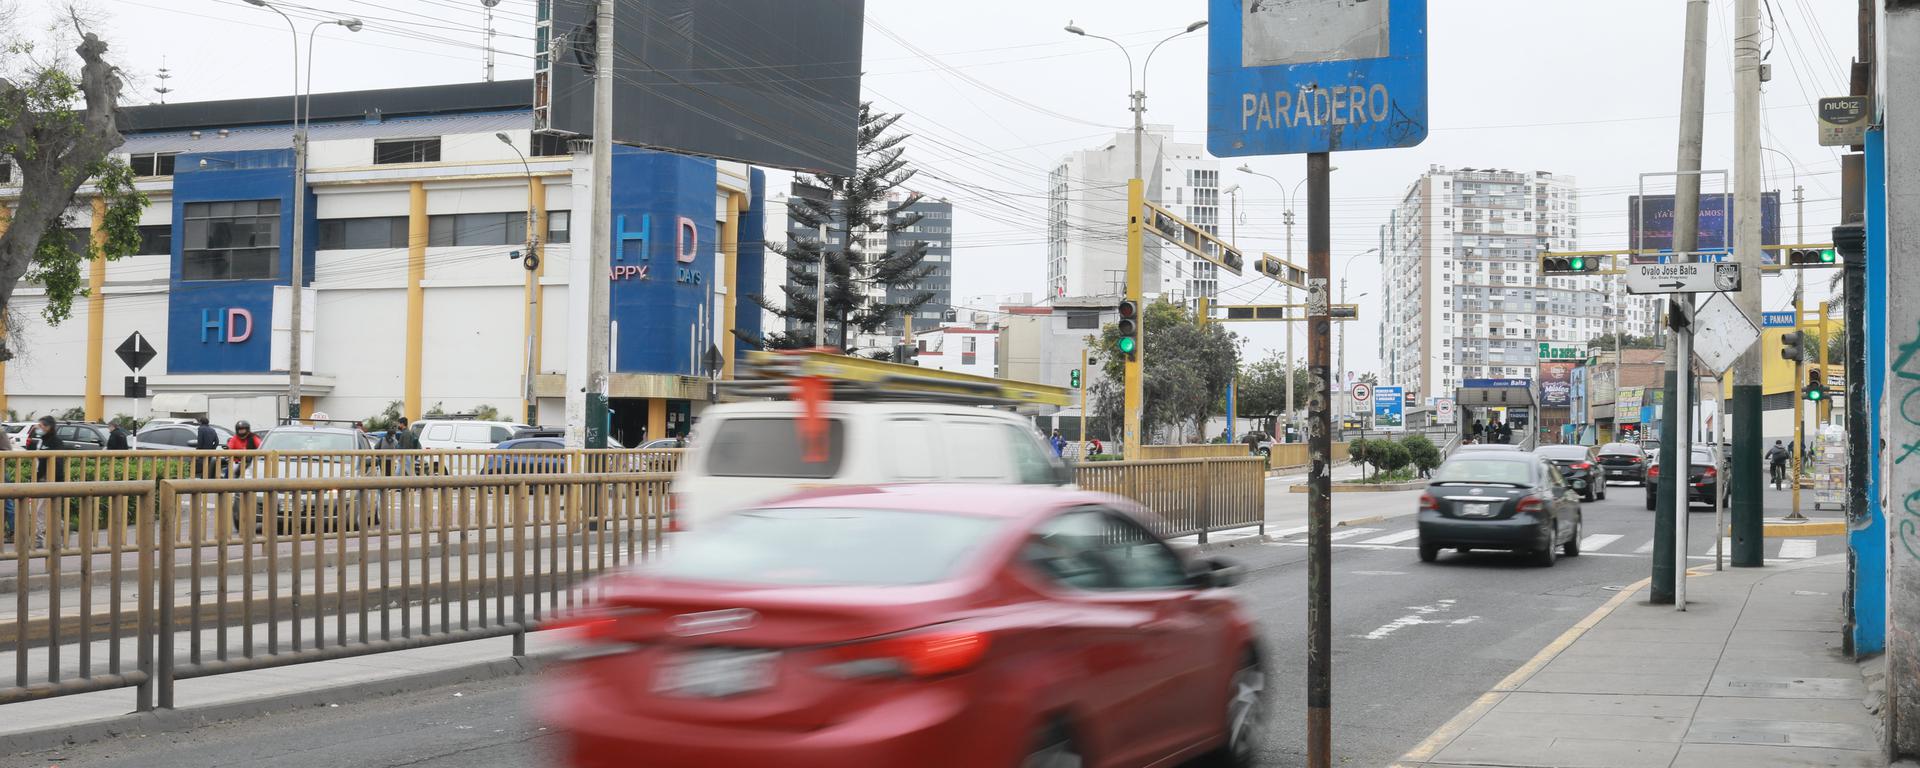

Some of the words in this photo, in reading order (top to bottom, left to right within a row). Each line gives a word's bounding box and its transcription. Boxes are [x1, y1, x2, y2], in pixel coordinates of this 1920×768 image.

[1242, 84, 1389, 130] PARADERO
[1825, 101, 1859, 110] niubiz
[608, 265, 647, 280] APPY
[678, 268, 701, 284] DAYS
[1641, 265, 1660, 276] Ovalo
[1662, 264, 1677, 275] José
[1680, 264, 1697, 275] Balta
[202, 308, 253, 343] HD
